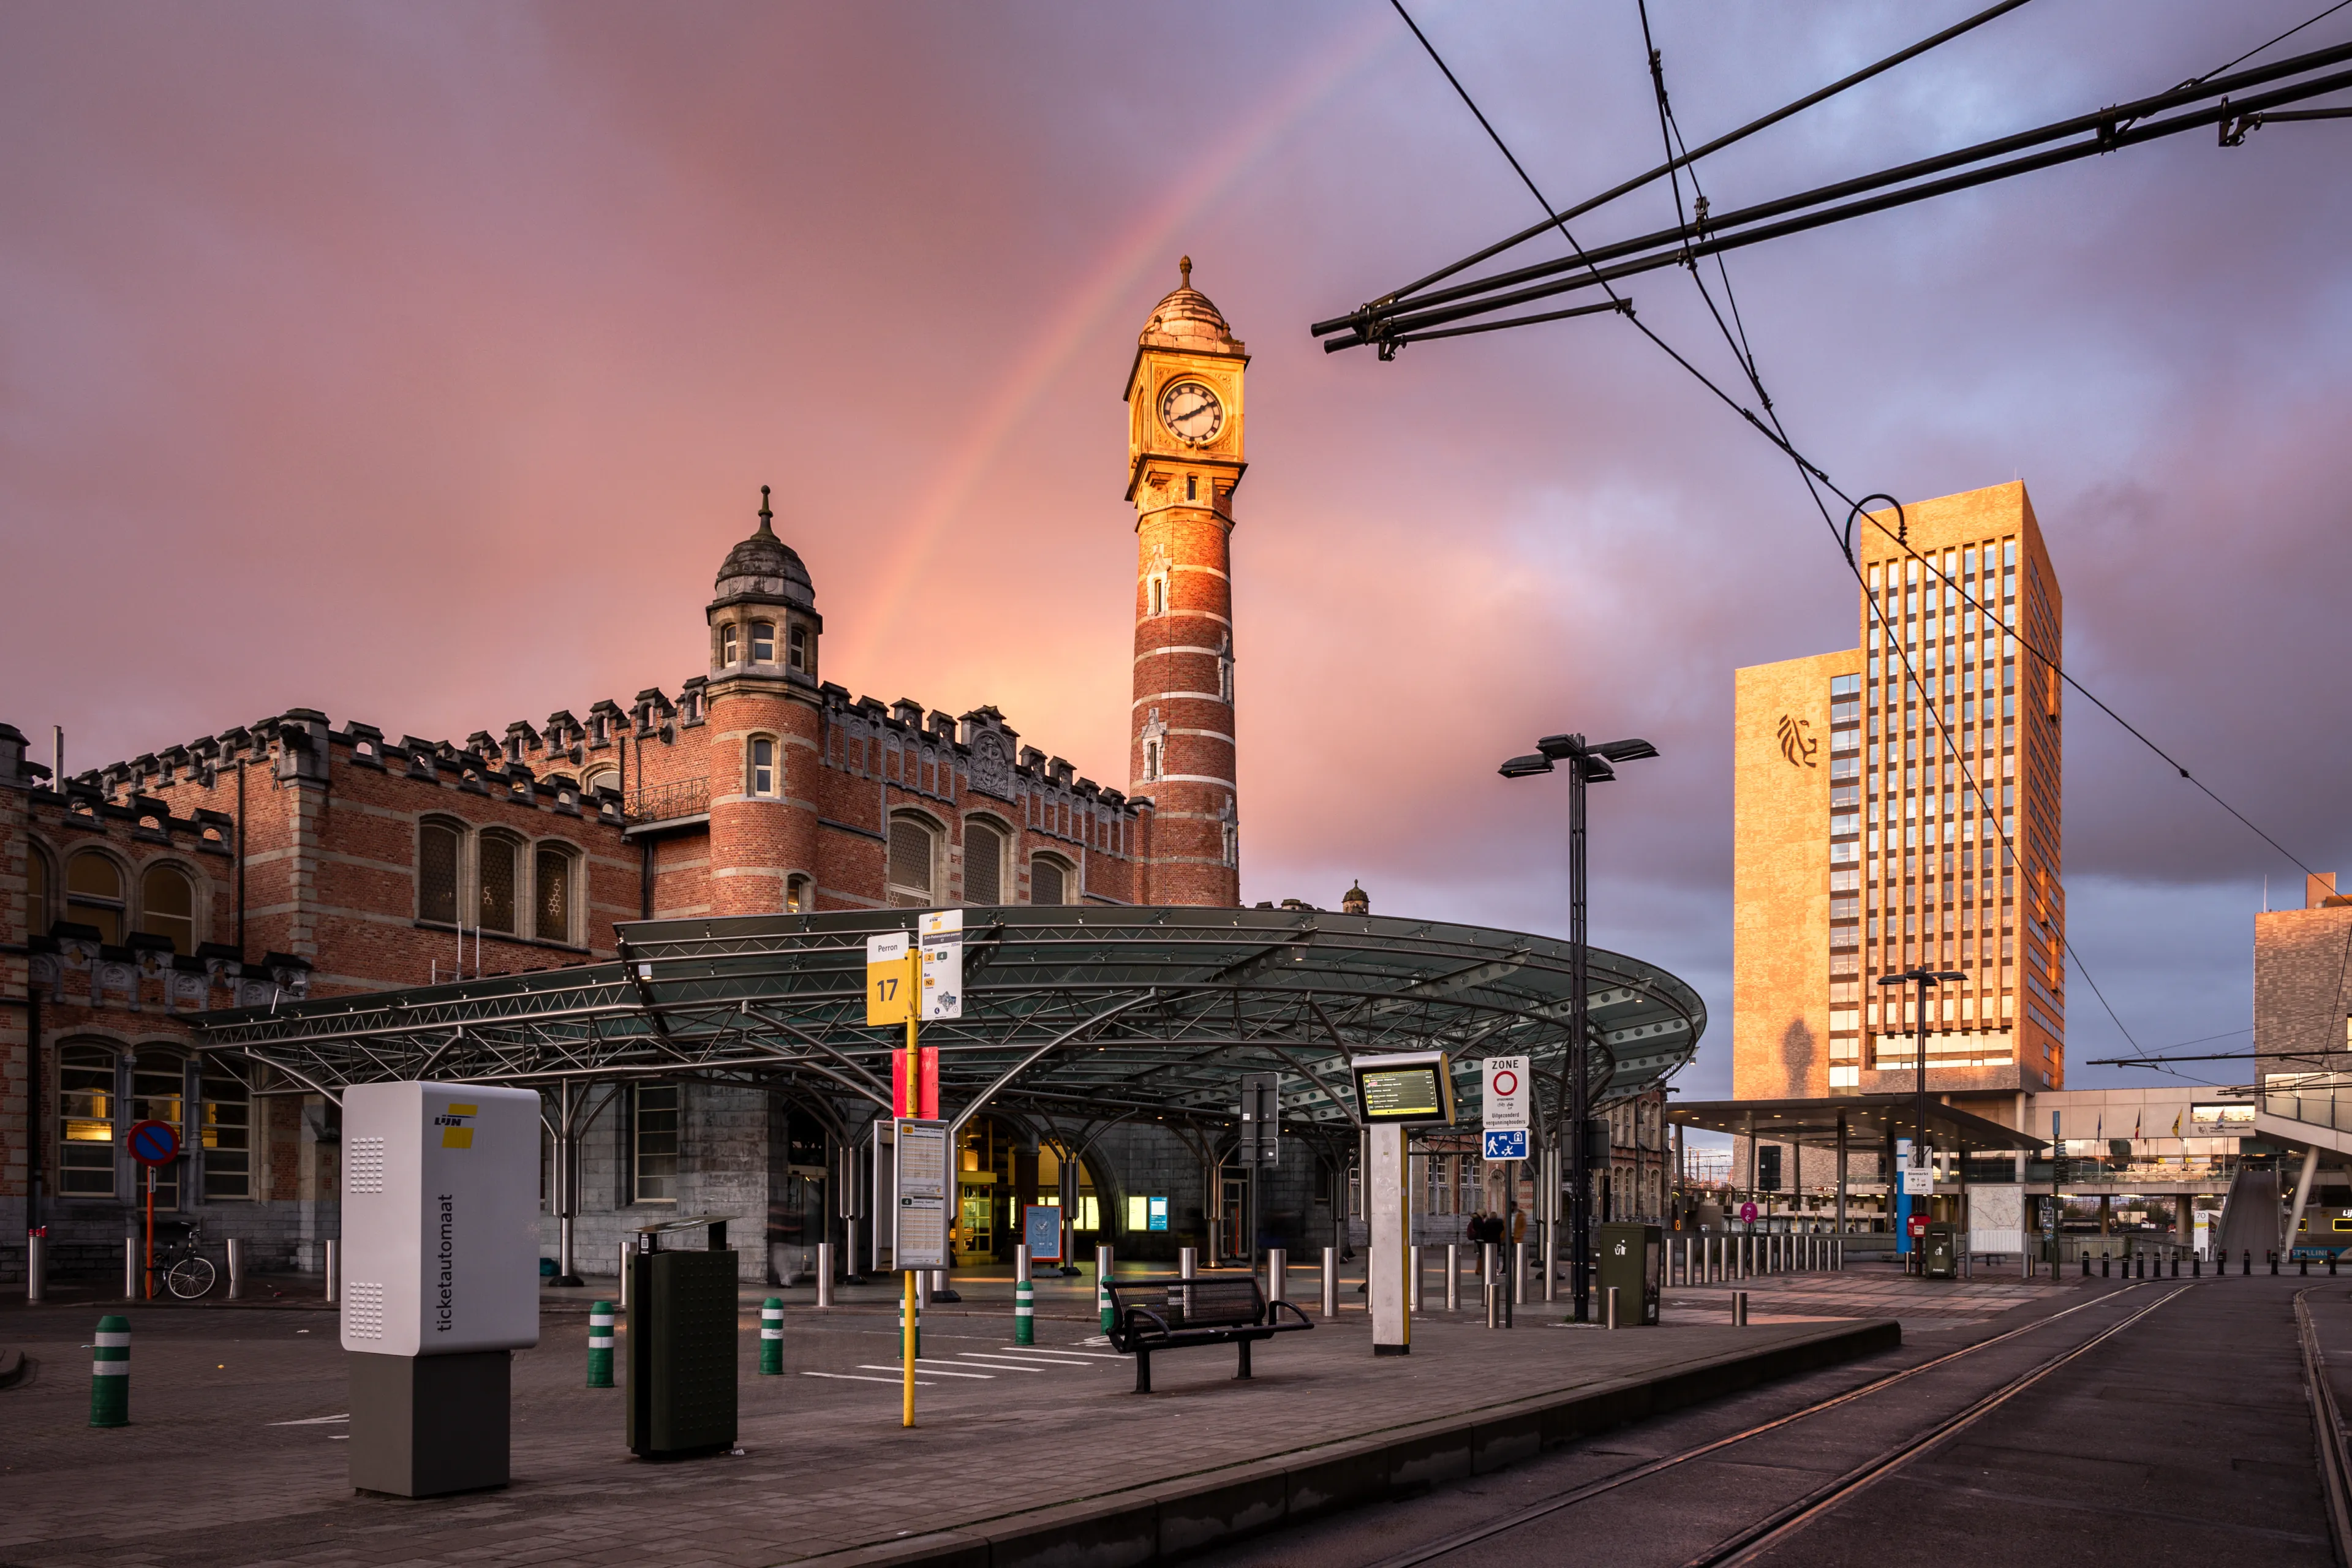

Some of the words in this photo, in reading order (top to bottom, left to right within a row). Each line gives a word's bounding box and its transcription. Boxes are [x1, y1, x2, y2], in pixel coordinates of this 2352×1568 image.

[878, 944, 898, 953] Perron
[877, 978, 899, 1002] 17
[1492, 1060, 1519, 1069] ZONE
[437, 1194, 453, 1332] ticketautomaat
